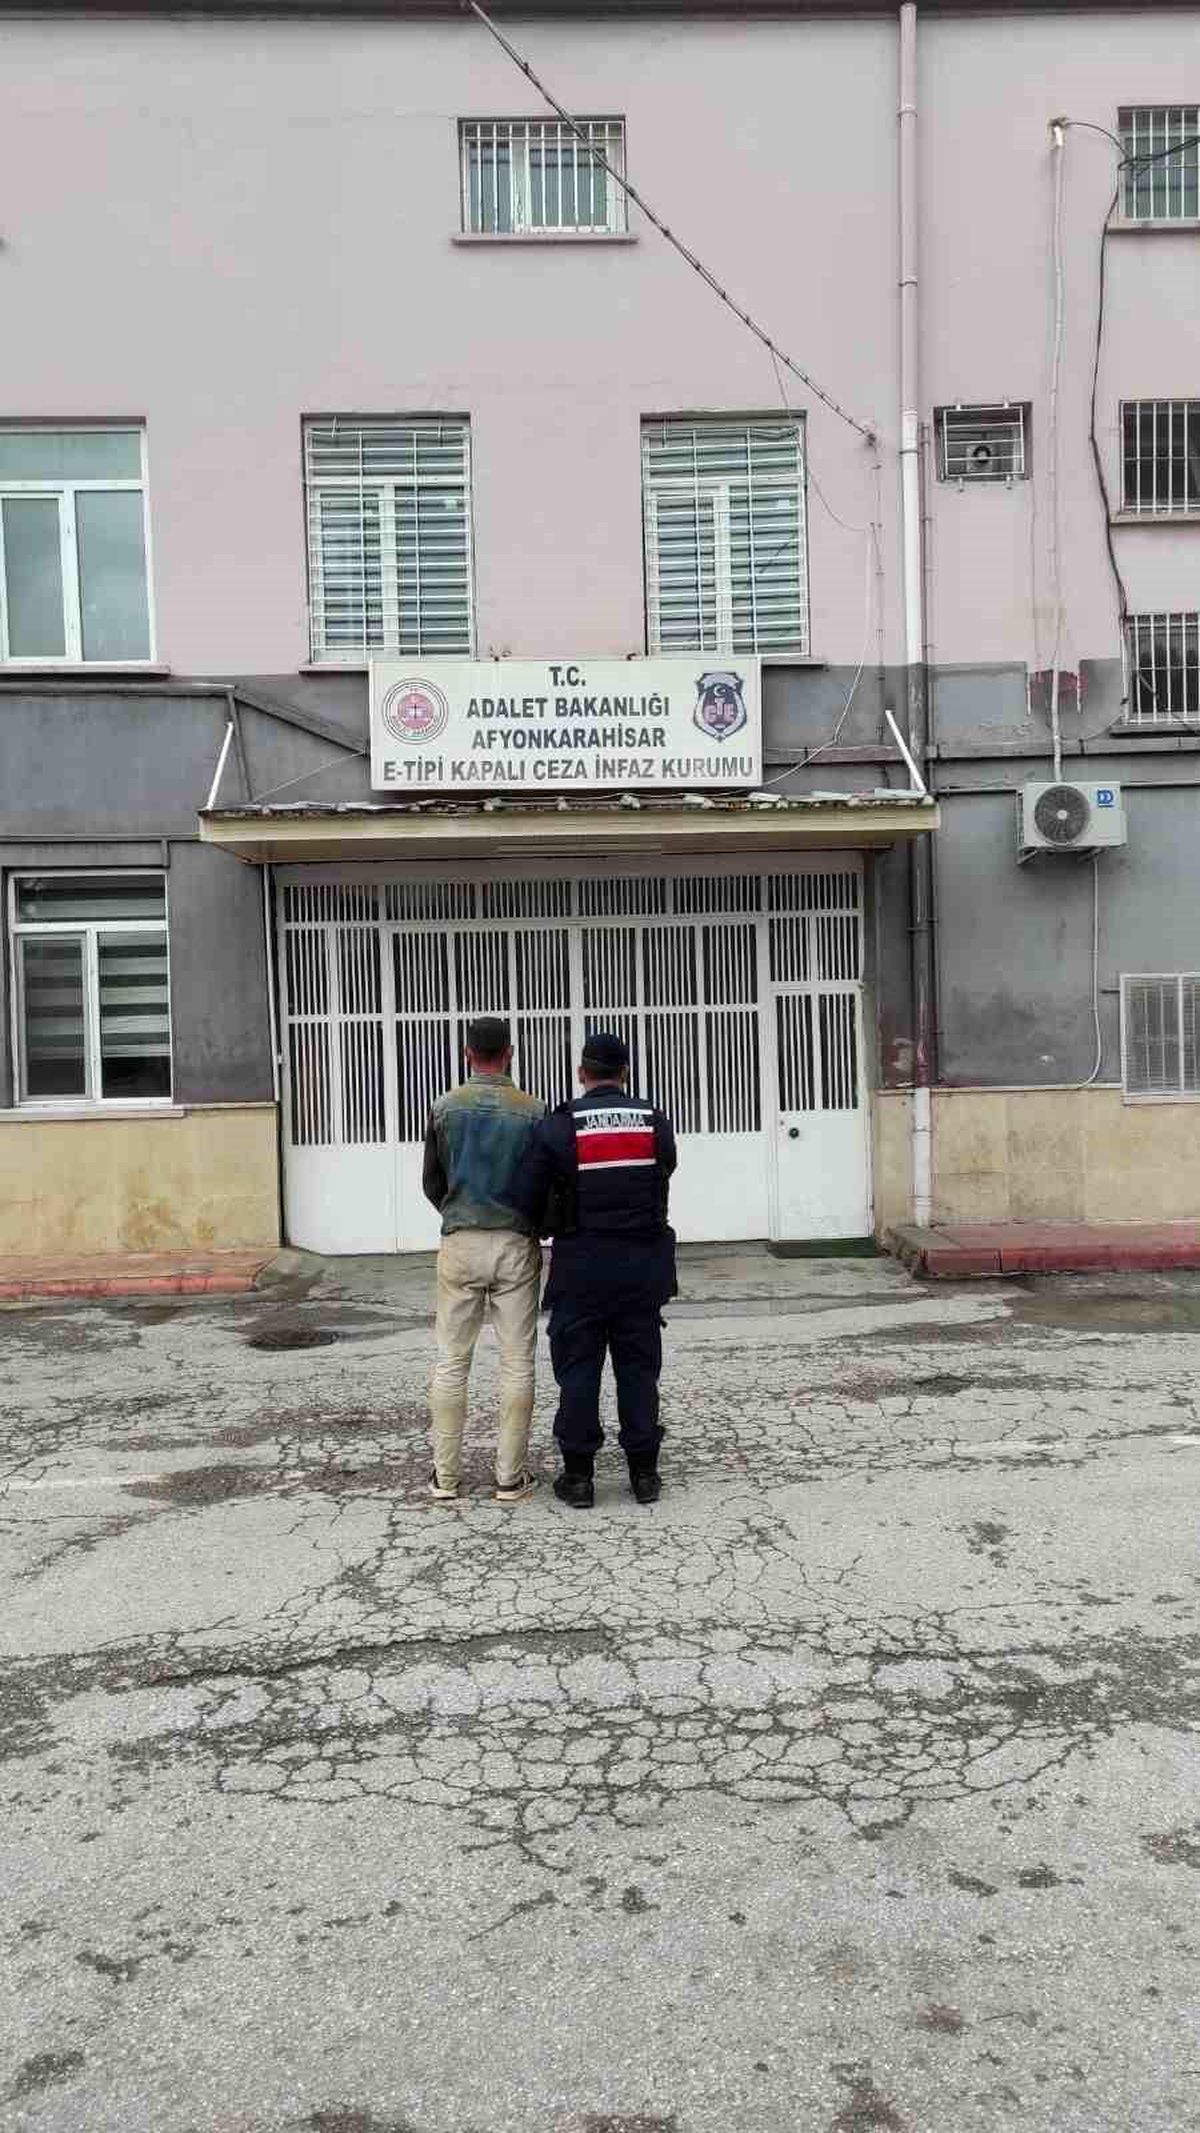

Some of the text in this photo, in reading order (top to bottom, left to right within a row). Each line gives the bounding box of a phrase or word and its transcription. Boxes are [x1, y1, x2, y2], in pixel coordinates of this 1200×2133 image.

[549, 666, 586, 686] T.C.
[466, 698, 548, 718] ADALET
[555, 693, 670, 718] BAKANLIĞI
[472, 723, 667, 749] AFYONKARAHİSAR
[383, 754, 753, 781] E-TİPİ KAPALI CEZA İNFAZ KURUMU
